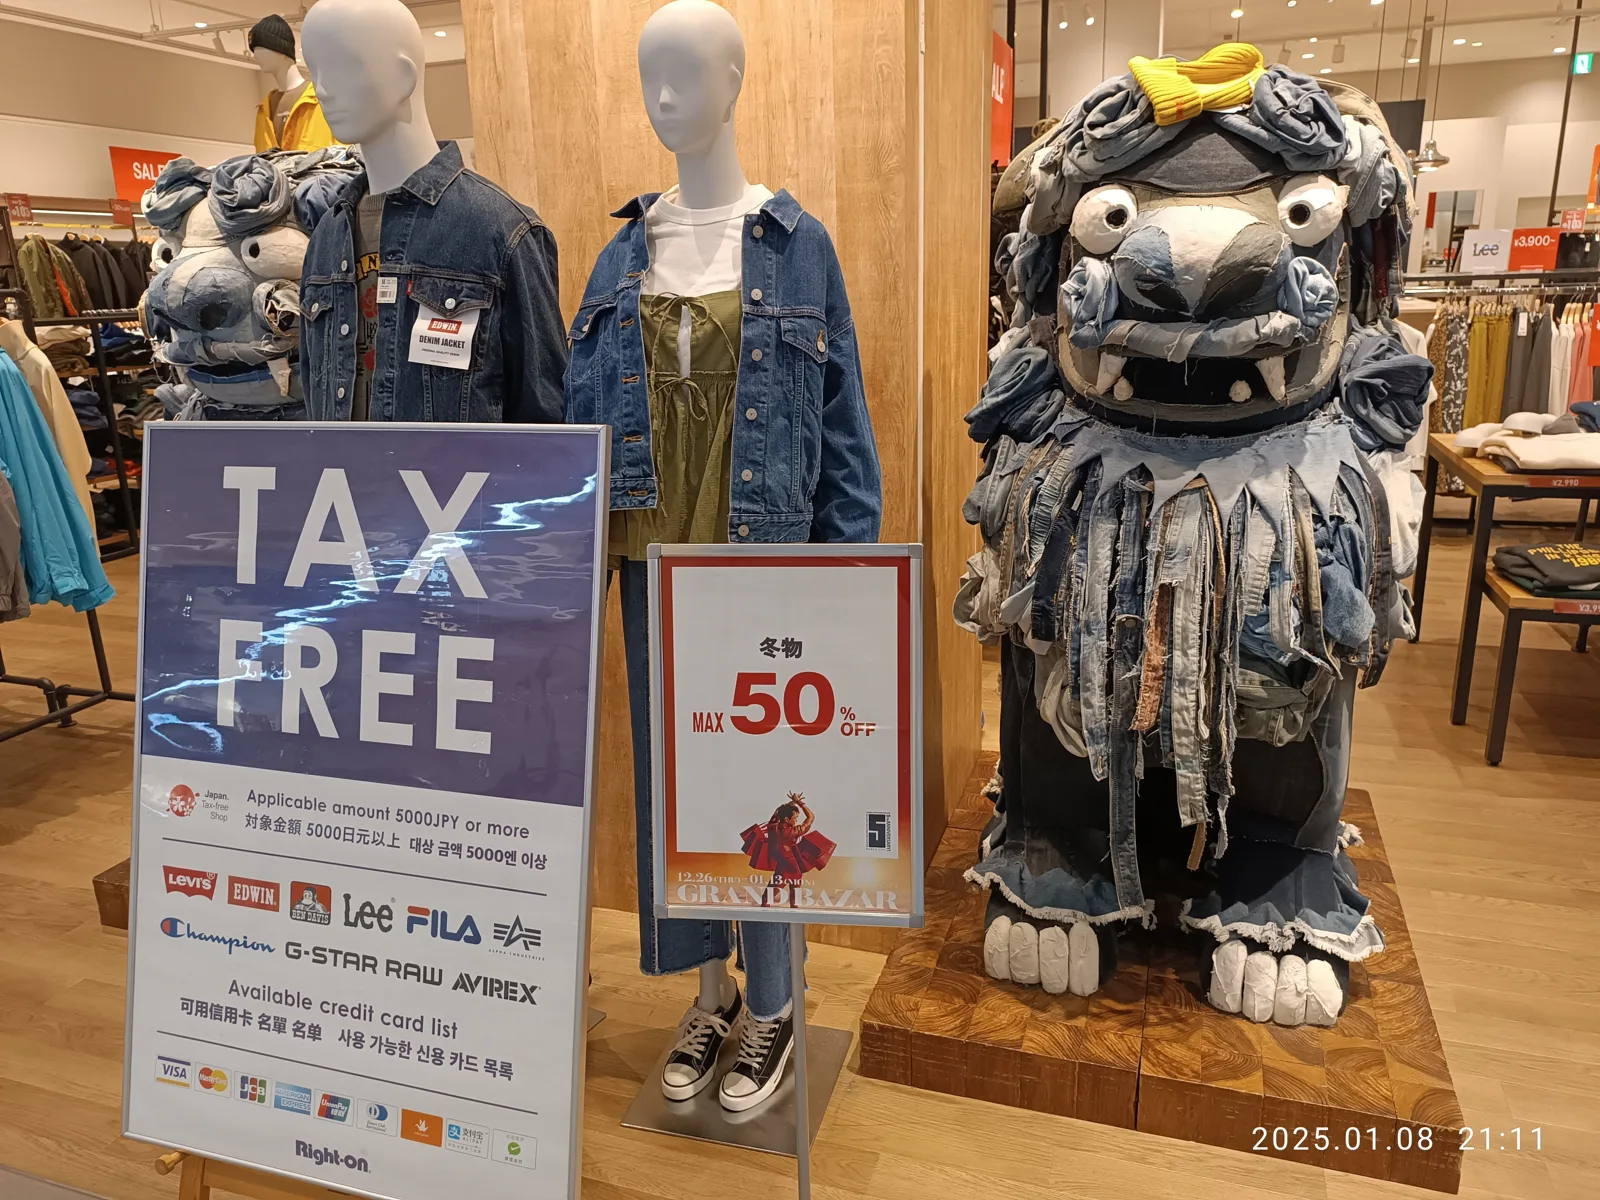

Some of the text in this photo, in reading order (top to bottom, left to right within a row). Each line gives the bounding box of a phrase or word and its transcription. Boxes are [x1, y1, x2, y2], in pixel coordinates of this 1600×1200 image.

[1472, 243, 1499, 257] Lee
[431, 320, 458, 331] EDWIN
[419, 335, 466, 349] DENIM JACKET
[223, 466, 490, 599] TAX
[759, 636, 803, 659] 冬物
[216, 619, 495, 755] FREE
[692, 711, 724, 733] MAX
[730, 671, 836, 736] 50
[840, 722, 876, 737] OFF
[201, 800, 229, 812] Tax-free
[210, 811, 228, 822] Shop
[246, 789, 530, 839] Applicable amount 5000JPY or more
[244, 812, 401, 849] 対象金額 5000日元以上
[409, 838, 548, 870] 대상 금액 5000엔 이상
[233, 882, 276, 906] EDWIN
[677, 884, 899, 910] GRAND BAZAR
[292, 909, 329, 925] BEN DAVIS
[343, 893, 394, 933] Lee
[406, 905, 482, 945] FILA
[160, 917, 276, 954] Champion
[285, 941, 443, 987] G-STAR RAW
[452, 972, 538, 1006] AVIREX
[180, 996, 322, 1042] 可用信用卡 名單 名单
[228, 979, 458, 1040] Available credit card list
[338, 1028, 514, 1082] 사용 가능한 신용 카드 목록
[162, 1063, 188, 1080] VISA
[240, 1082, 266, 1097] JCB
[276, 1088, 310, 1101] AMERICAN
[282, 1098, 311, 1112] EXPRESS
[322, 1099, 348, 1113] UnionPay
[462, 1128, 484, 1140] 支付宝
[295, 1138, 370, 1173] Right-on
